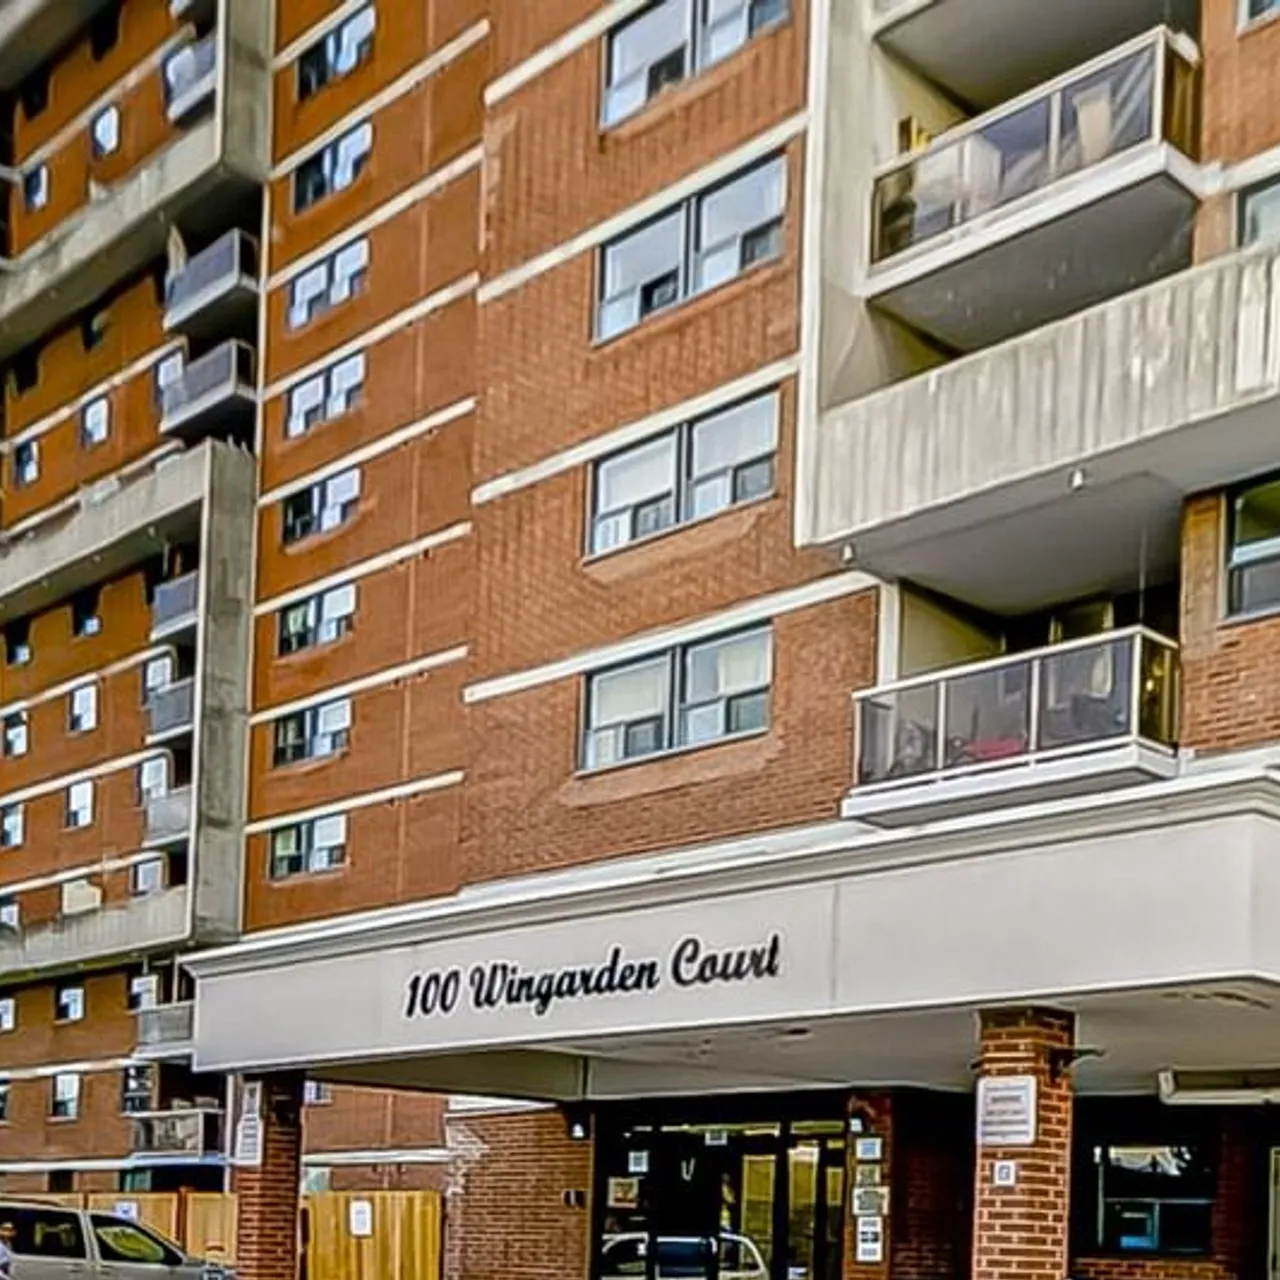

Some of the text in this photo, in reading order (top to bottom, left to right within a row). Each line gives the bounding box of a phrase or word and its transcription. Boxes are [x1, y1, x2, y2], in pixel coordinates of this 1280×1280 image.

[406, 933, 780, 1018] 100 Wingarden Court
